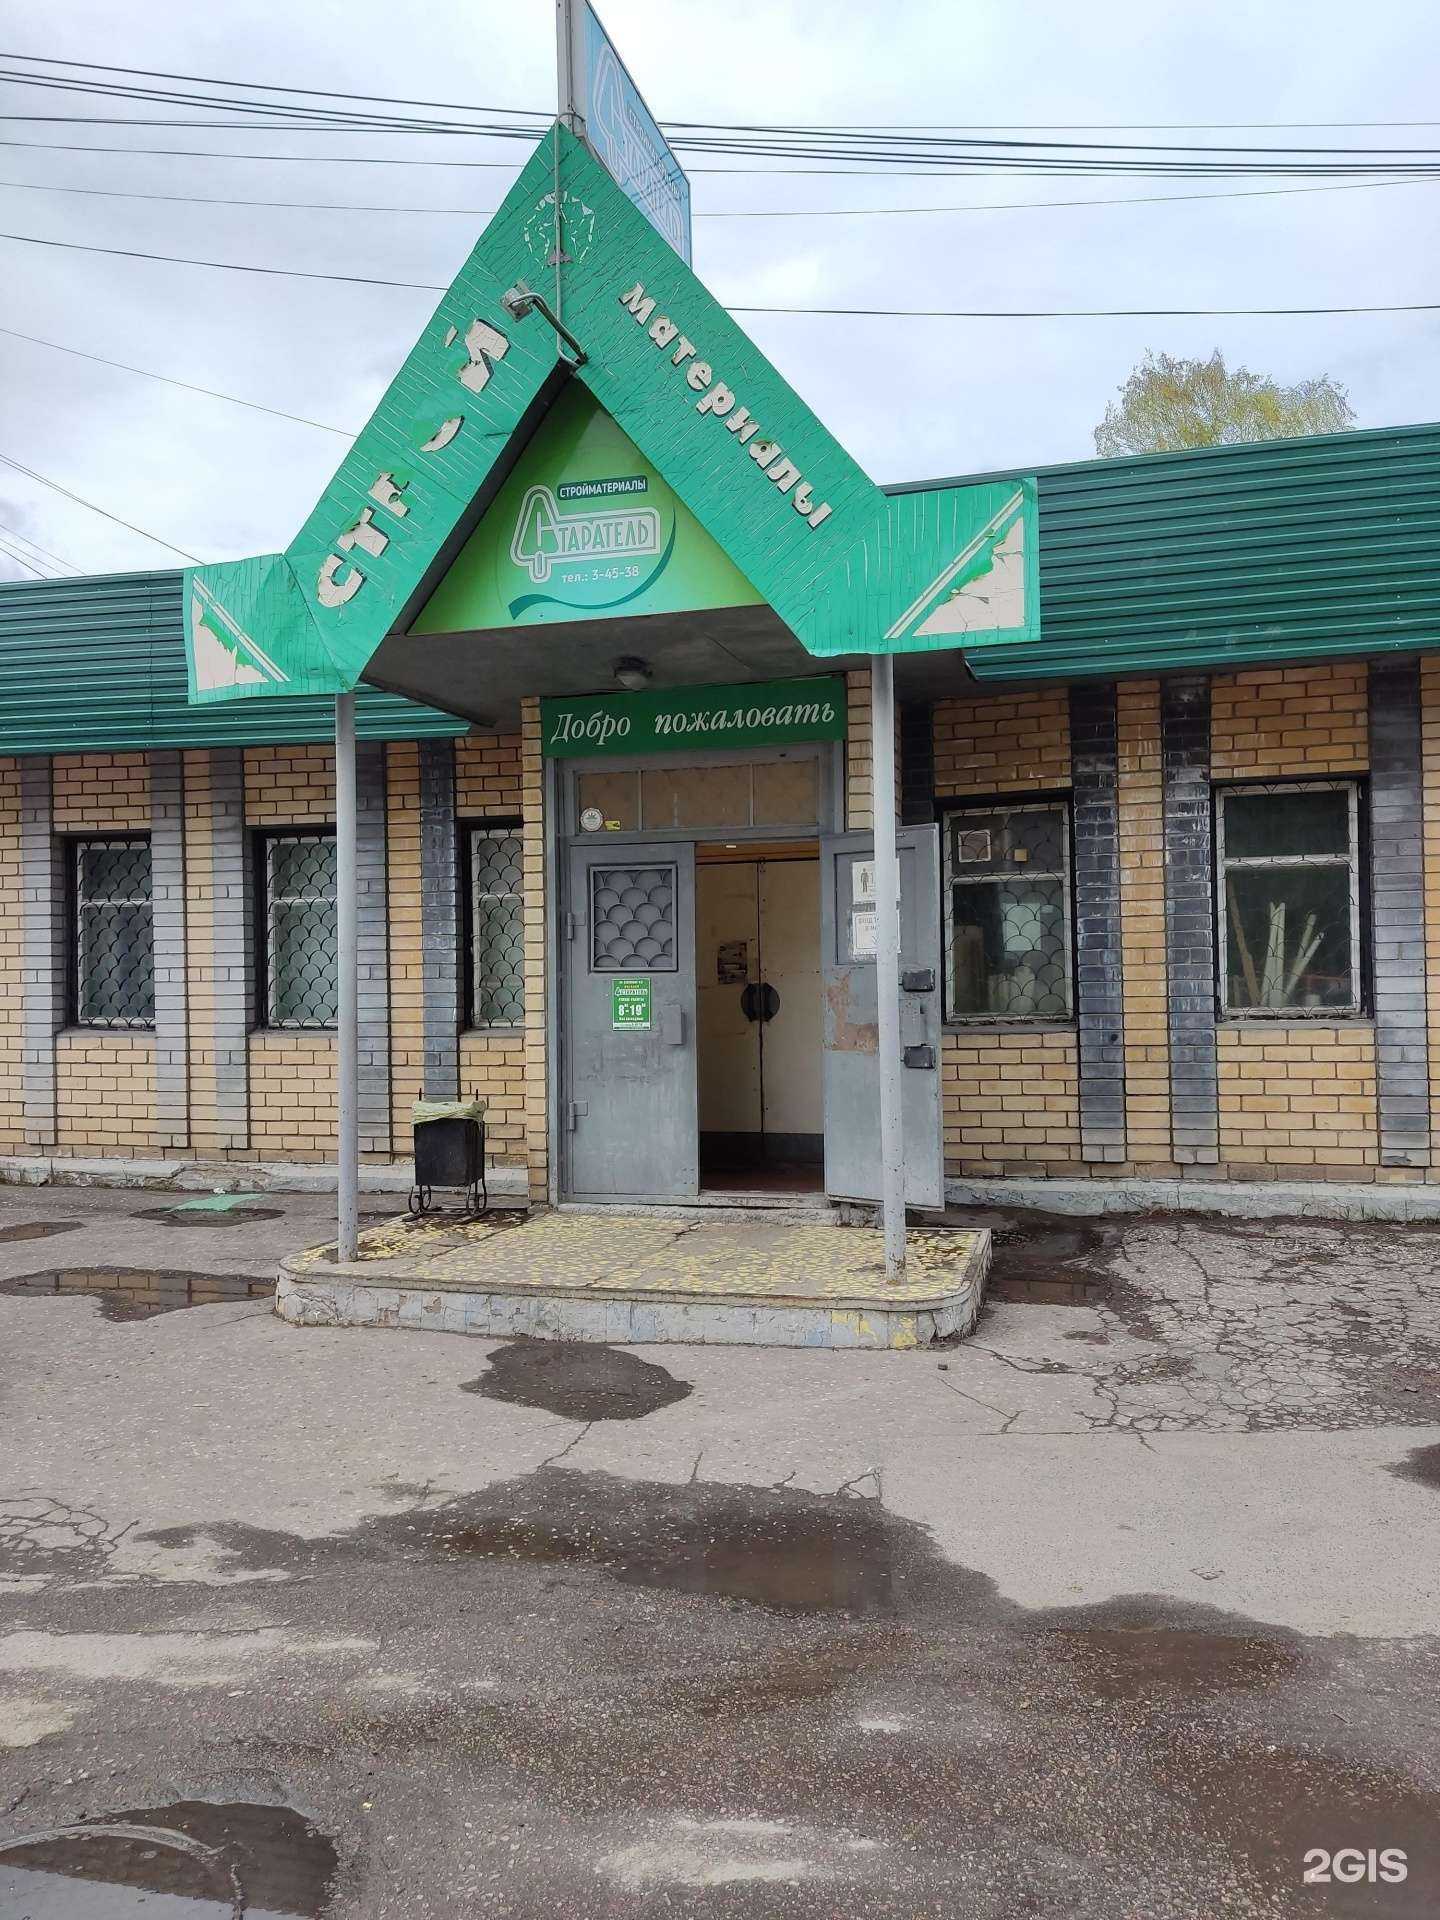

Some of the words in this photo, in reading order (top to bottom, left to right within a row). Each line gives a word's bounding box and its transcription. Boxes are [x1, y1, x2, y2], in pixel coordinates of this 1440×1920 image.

[558, 478, 647, 498] СТРОЙМАТЕРИАЛЫ
[561, 573, 589, 583] тел.:
[592, 565, 640, 581] 3-45-38
[550, 710, 631, 746] Добро
[654, 701, 836, 735] пожаловать
